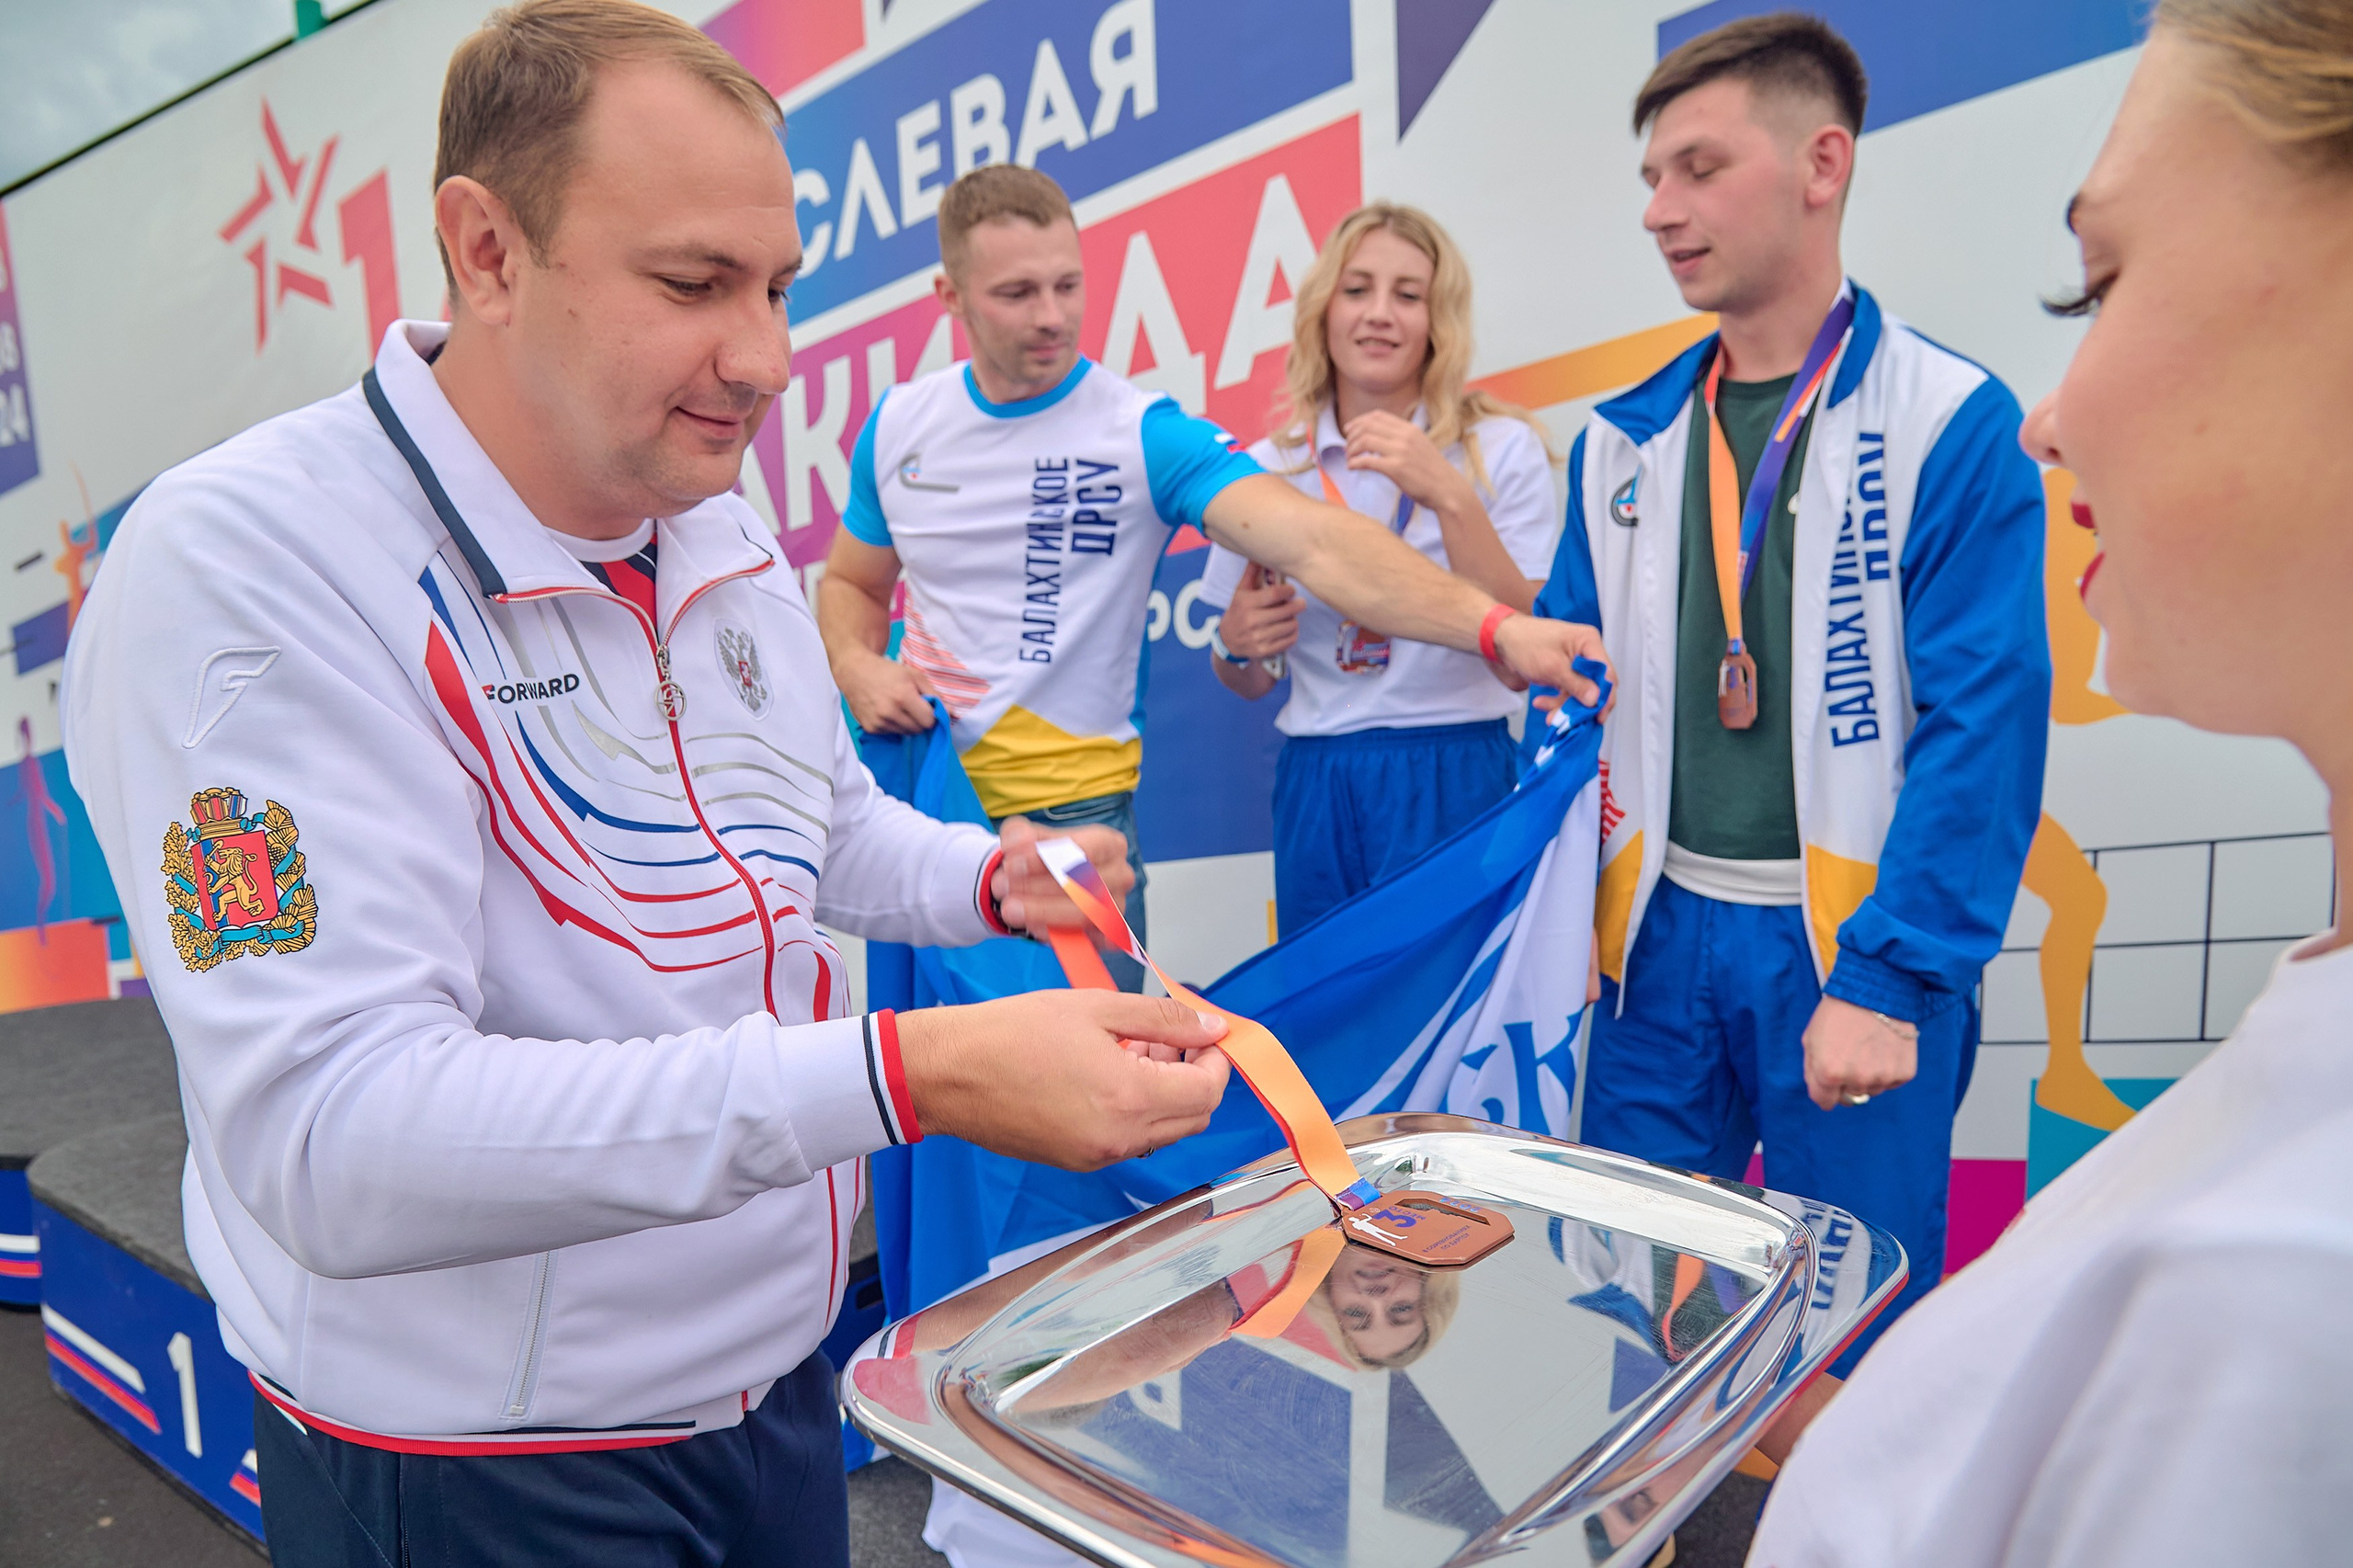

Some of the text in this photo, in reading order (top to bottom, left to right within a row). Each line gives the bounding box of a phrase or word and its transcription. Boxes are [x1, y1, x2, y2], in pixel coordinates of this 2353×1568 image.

[1071, 458, 1122, 556] ДРСУ
[481, 673, 580, 704] FORWARD
[1372, 1209, 1417, 1229] 3
[166, 1331, 203, 1460] 1
